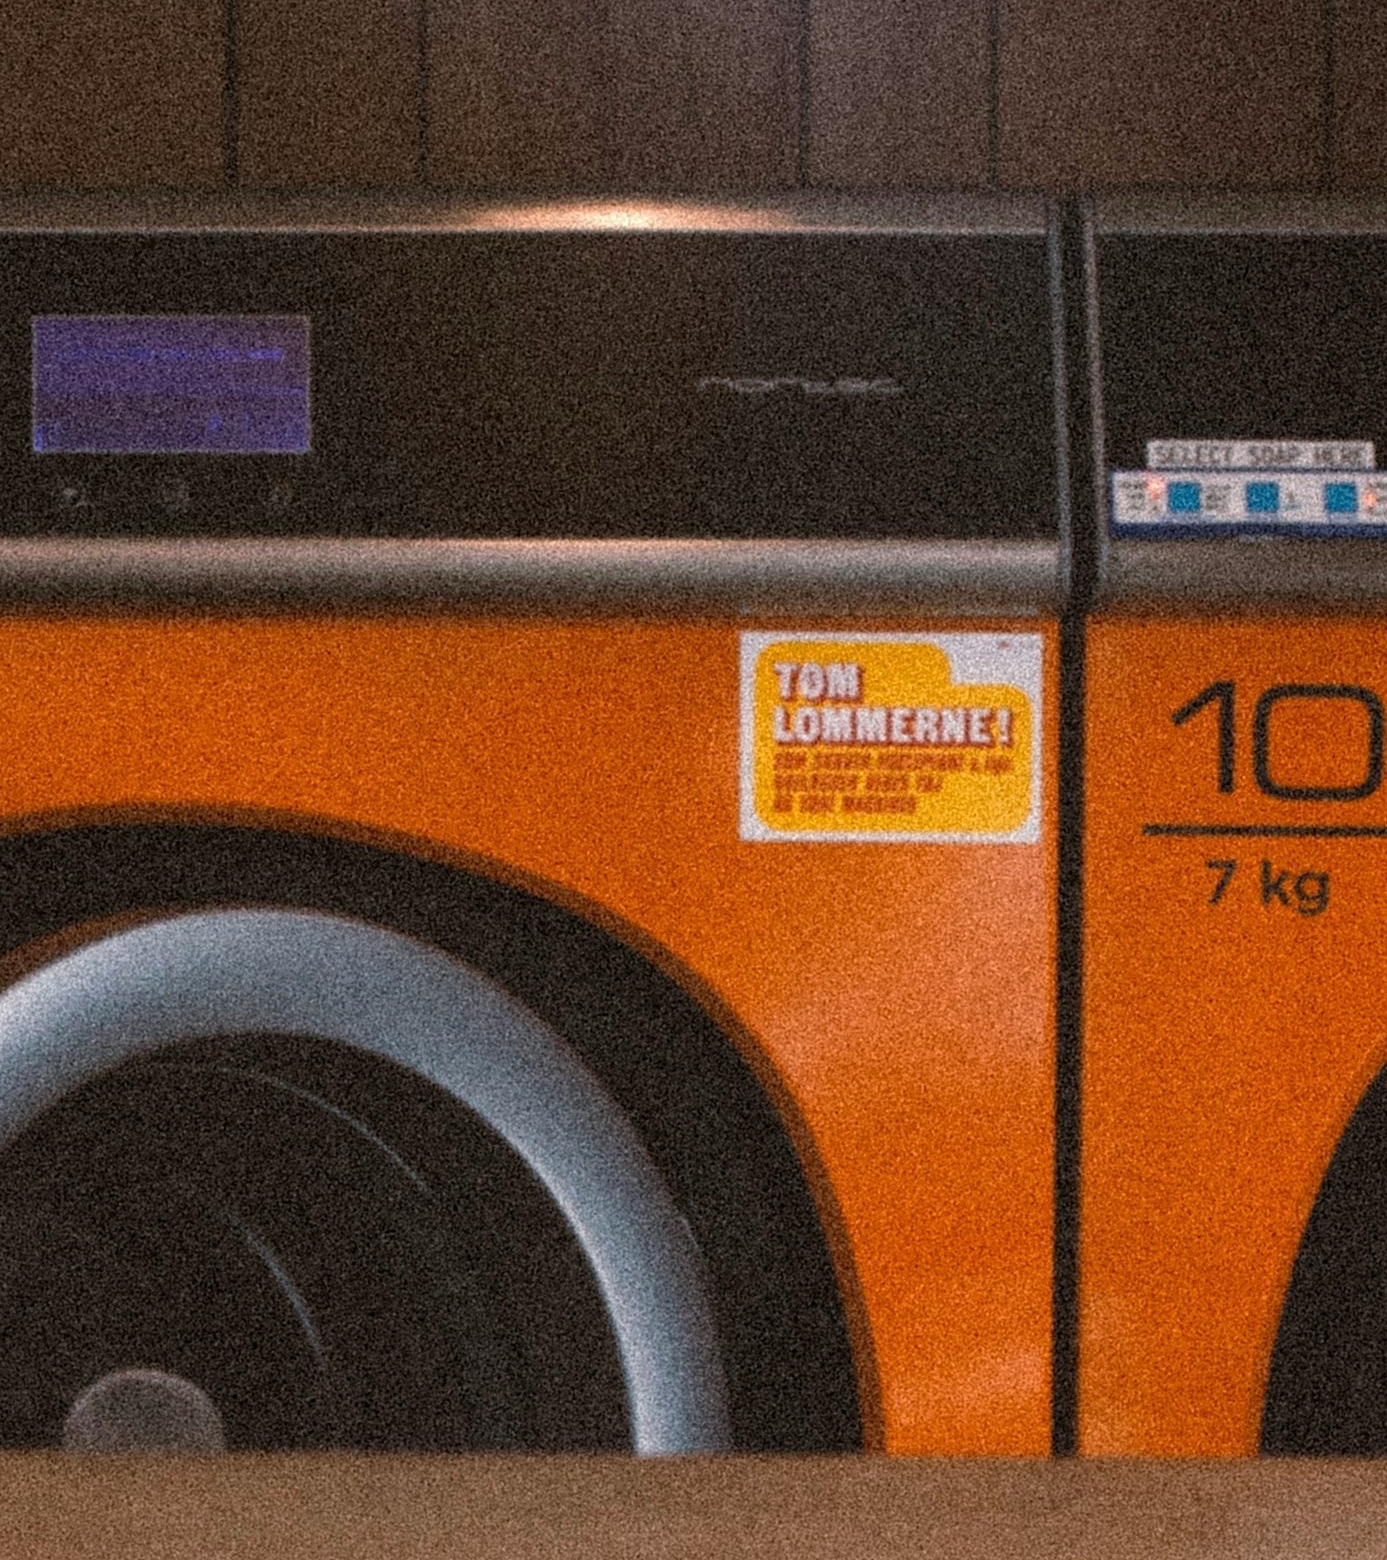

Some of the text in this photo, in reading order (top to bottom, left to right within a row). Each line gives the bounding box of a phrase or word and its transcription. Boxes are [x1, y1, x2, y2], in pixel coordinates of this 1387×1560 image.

[1154, 443, 1366, 466] SELECT SOAP HERE
[773, 661, 864, 702] TOM
[773, 707, 1014, 748] LOMMERNE!
[1171, 680, 1385, 802] 10
[1206, 860, 1330, 917] 7 kg
